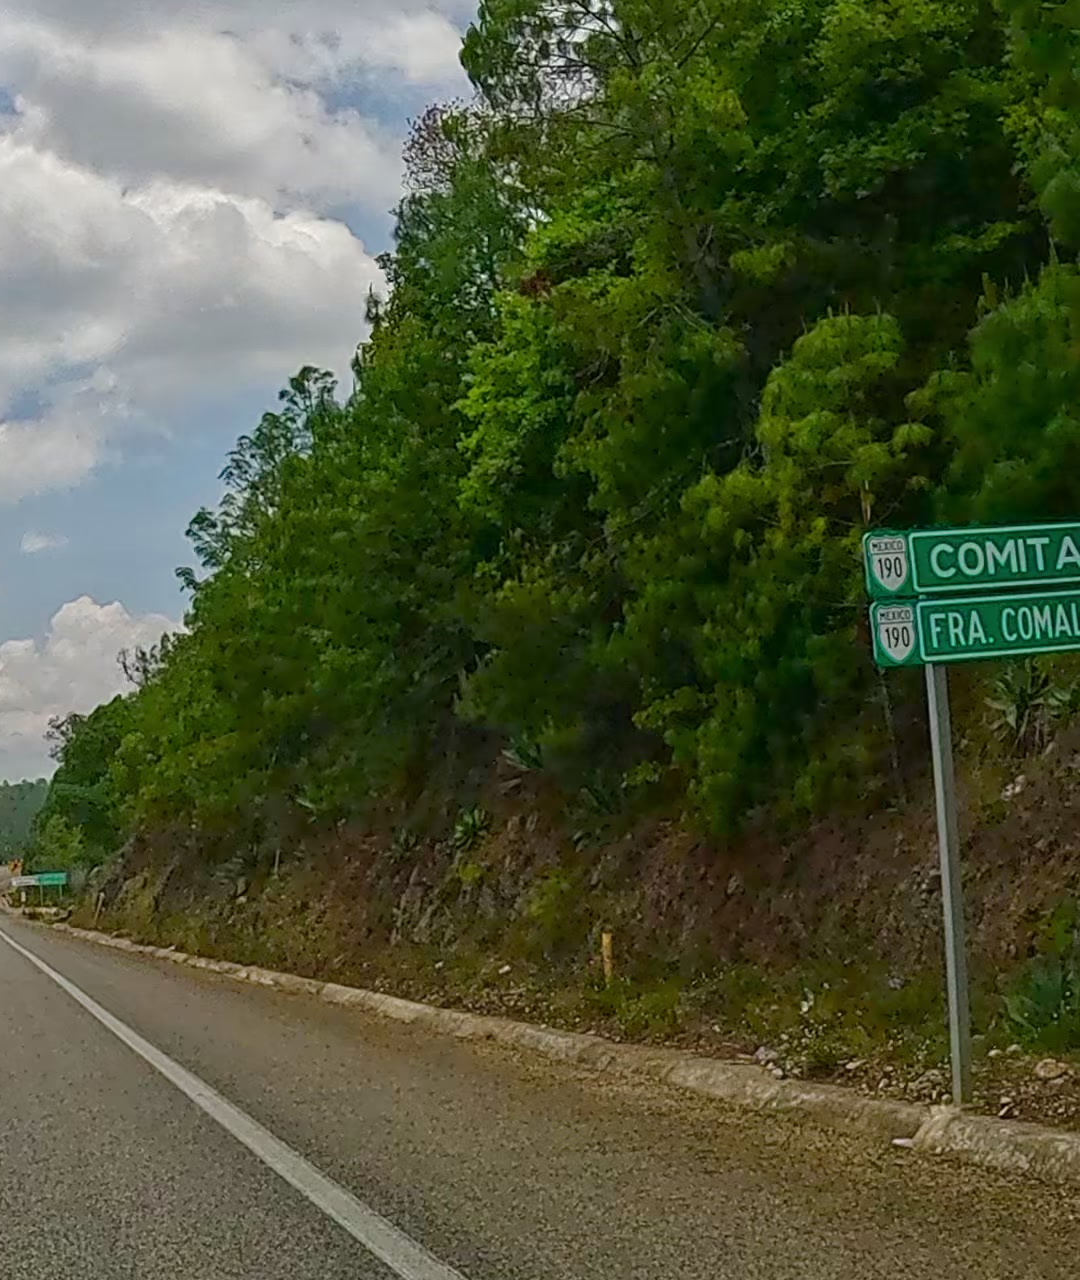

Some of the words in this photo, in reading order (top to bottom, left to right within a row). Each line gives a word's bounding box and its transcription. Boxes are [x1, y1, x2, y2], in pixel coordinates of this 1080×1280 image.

[877, 556, 903, 579] 190
[930, 535, 1080, 578] COMITA
[885, 626, 910, 649] 190
[929, 610, 995, 649] FRA.
[1001, 603, 1080, 641] COMAL
